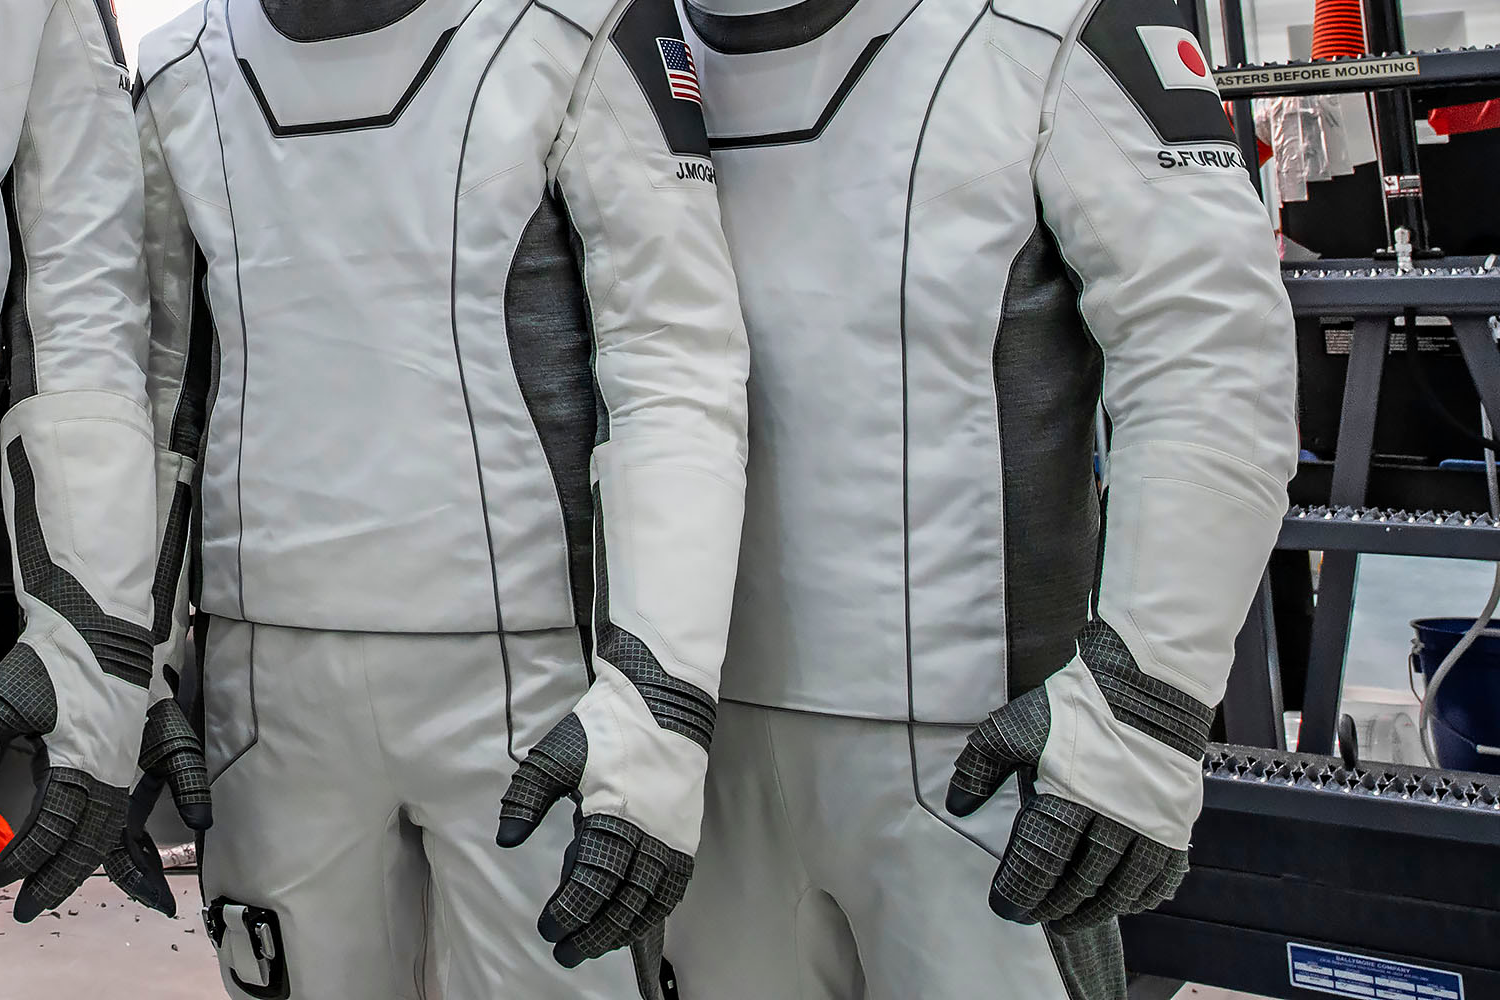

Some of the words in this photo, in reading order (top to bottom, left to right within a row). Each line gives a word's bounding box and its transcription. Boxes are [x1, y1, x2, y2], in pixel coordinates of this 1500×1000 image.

[1214, 72, 1270, 87] ASTERS
[1274, 68, 1331, 83] BEFORE
[1334, 61, 1416, 77] MOUNTING
[1335, 955, 1376, 968] BALLYMORE
[1377, 962, 1411, 974] COMPANY
